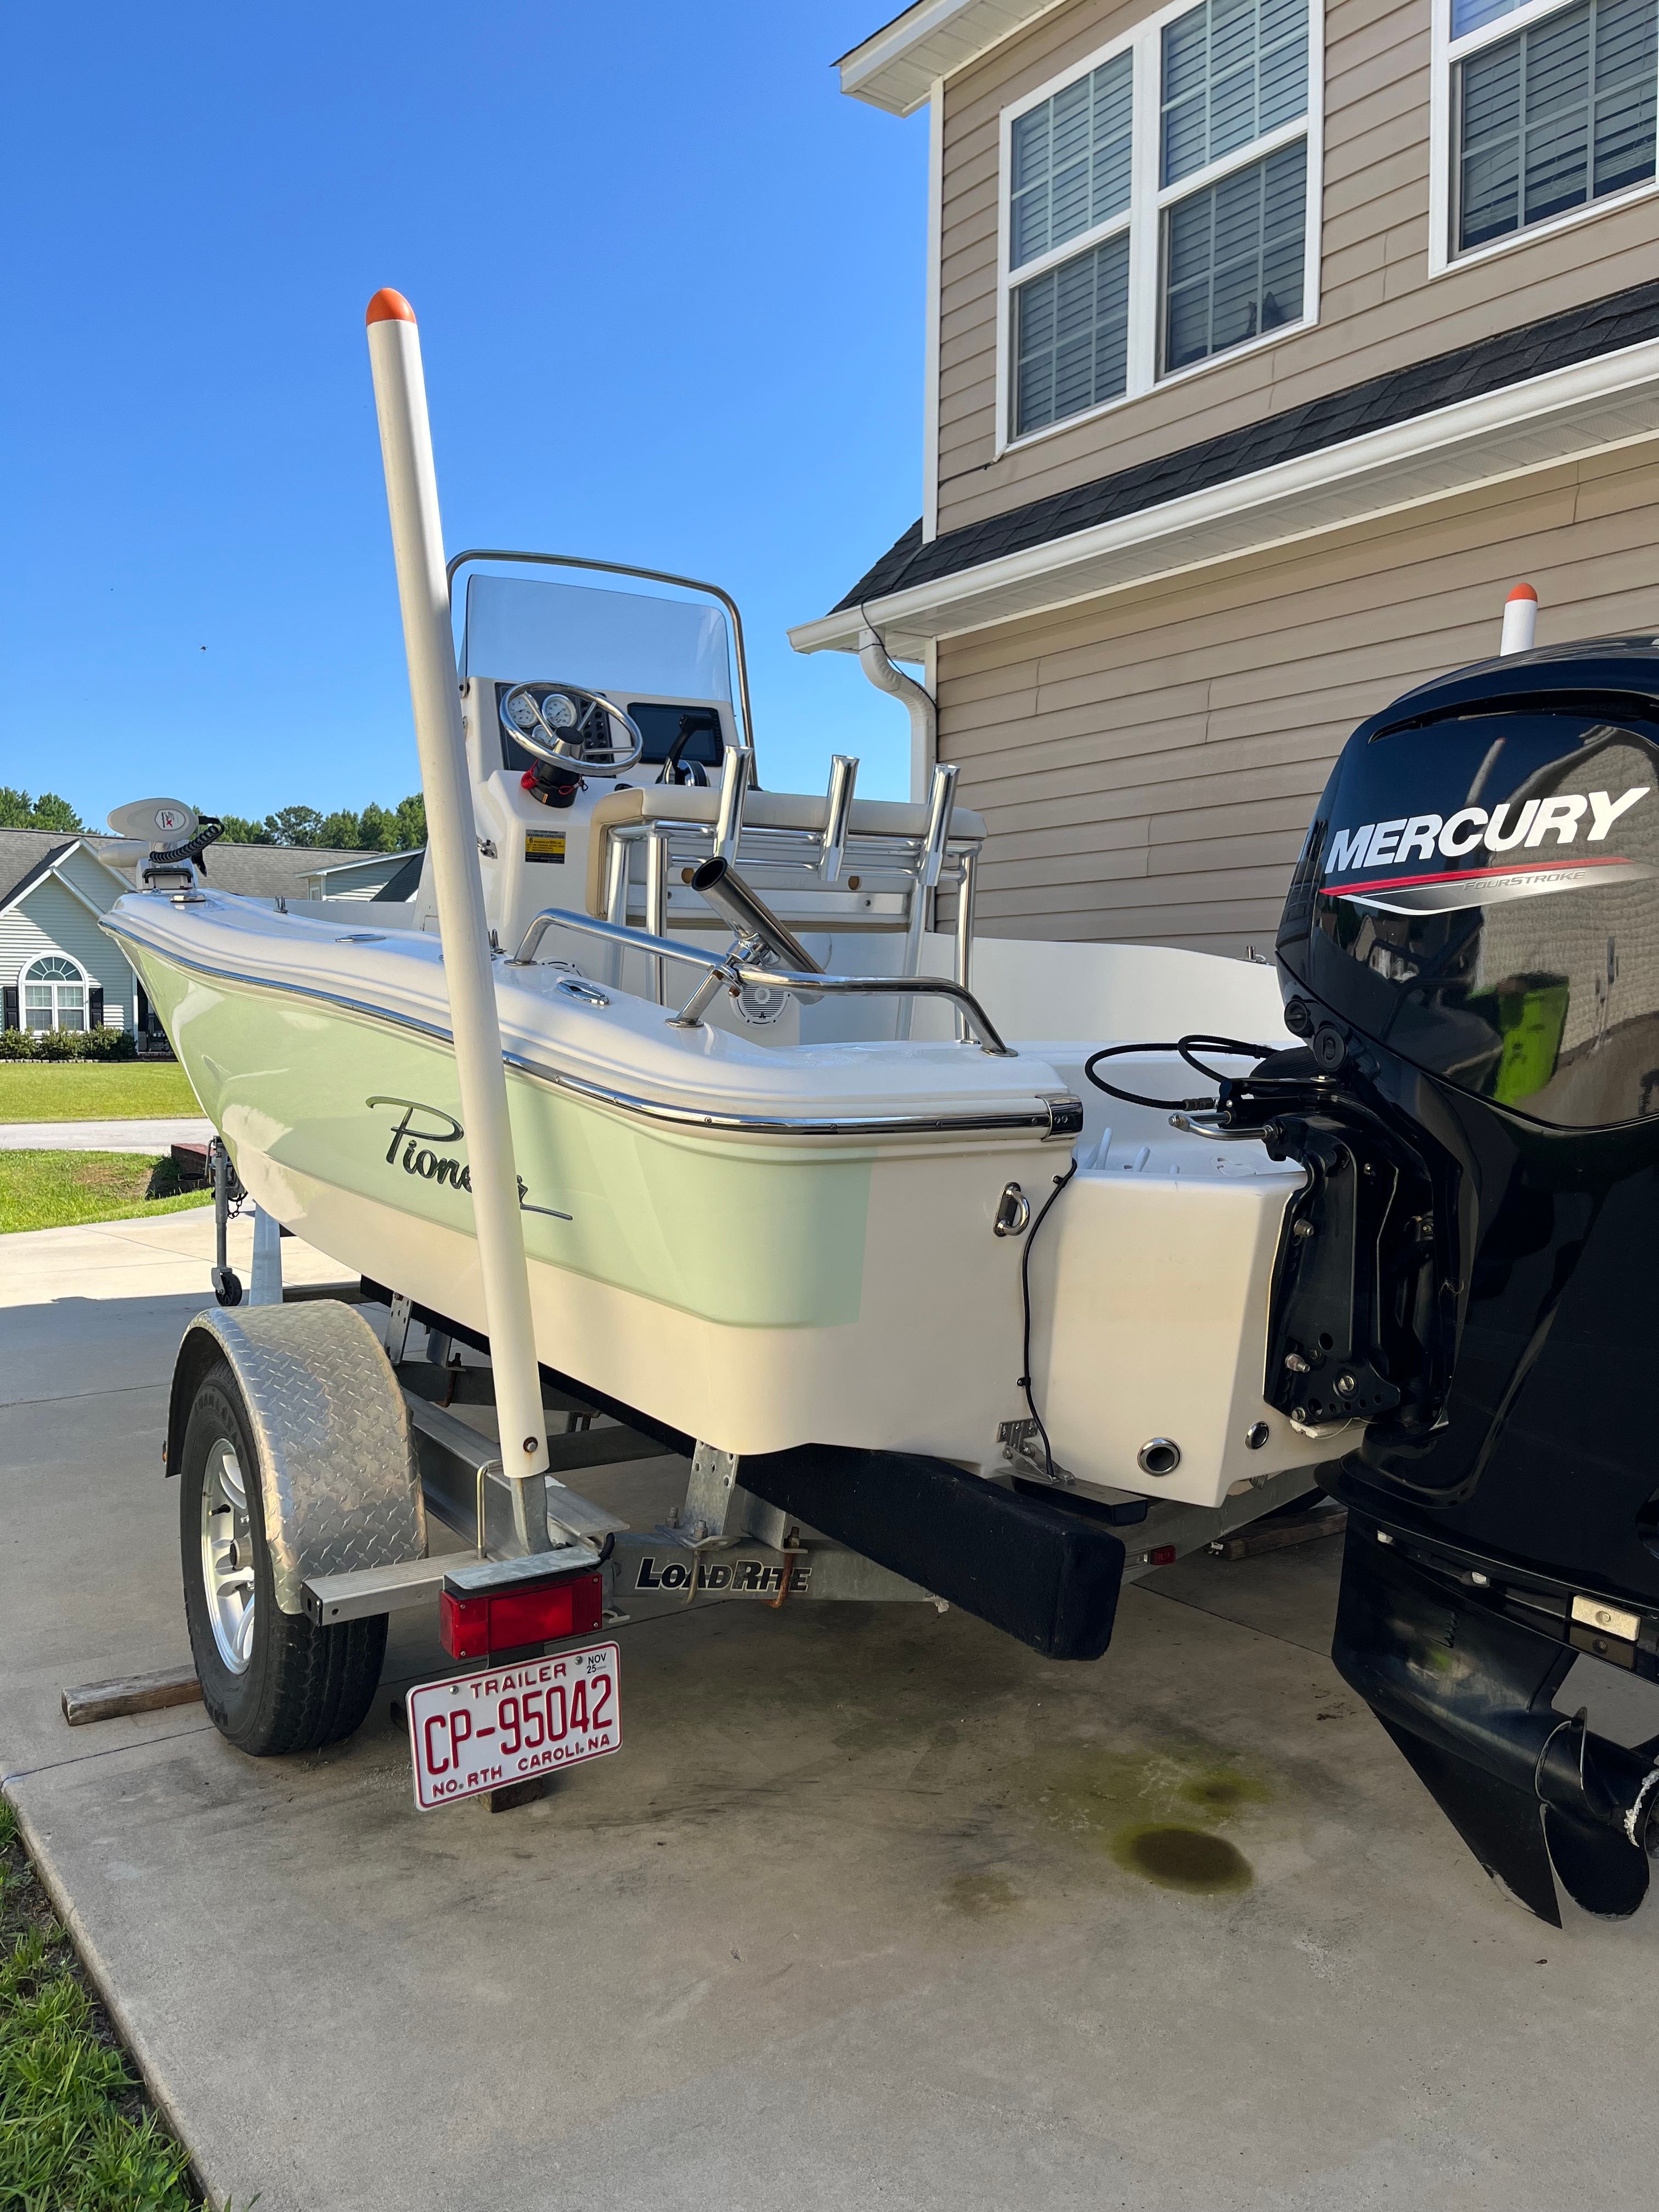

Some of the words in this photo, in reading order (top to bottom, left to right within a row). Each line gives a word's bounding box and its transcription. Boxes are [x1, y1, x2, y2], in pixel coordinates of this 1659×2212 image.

[1324, 787, 1651, 874] MERCURY
[586, 1664, 596, 1674] 25
[588, 1652, 606, 1665] NOV
[470, 1663, 567, 1699] TRAILER
[424, 1674, 612, 1775] CP-95042
[432, 1765, 502, 1798] NORTH
